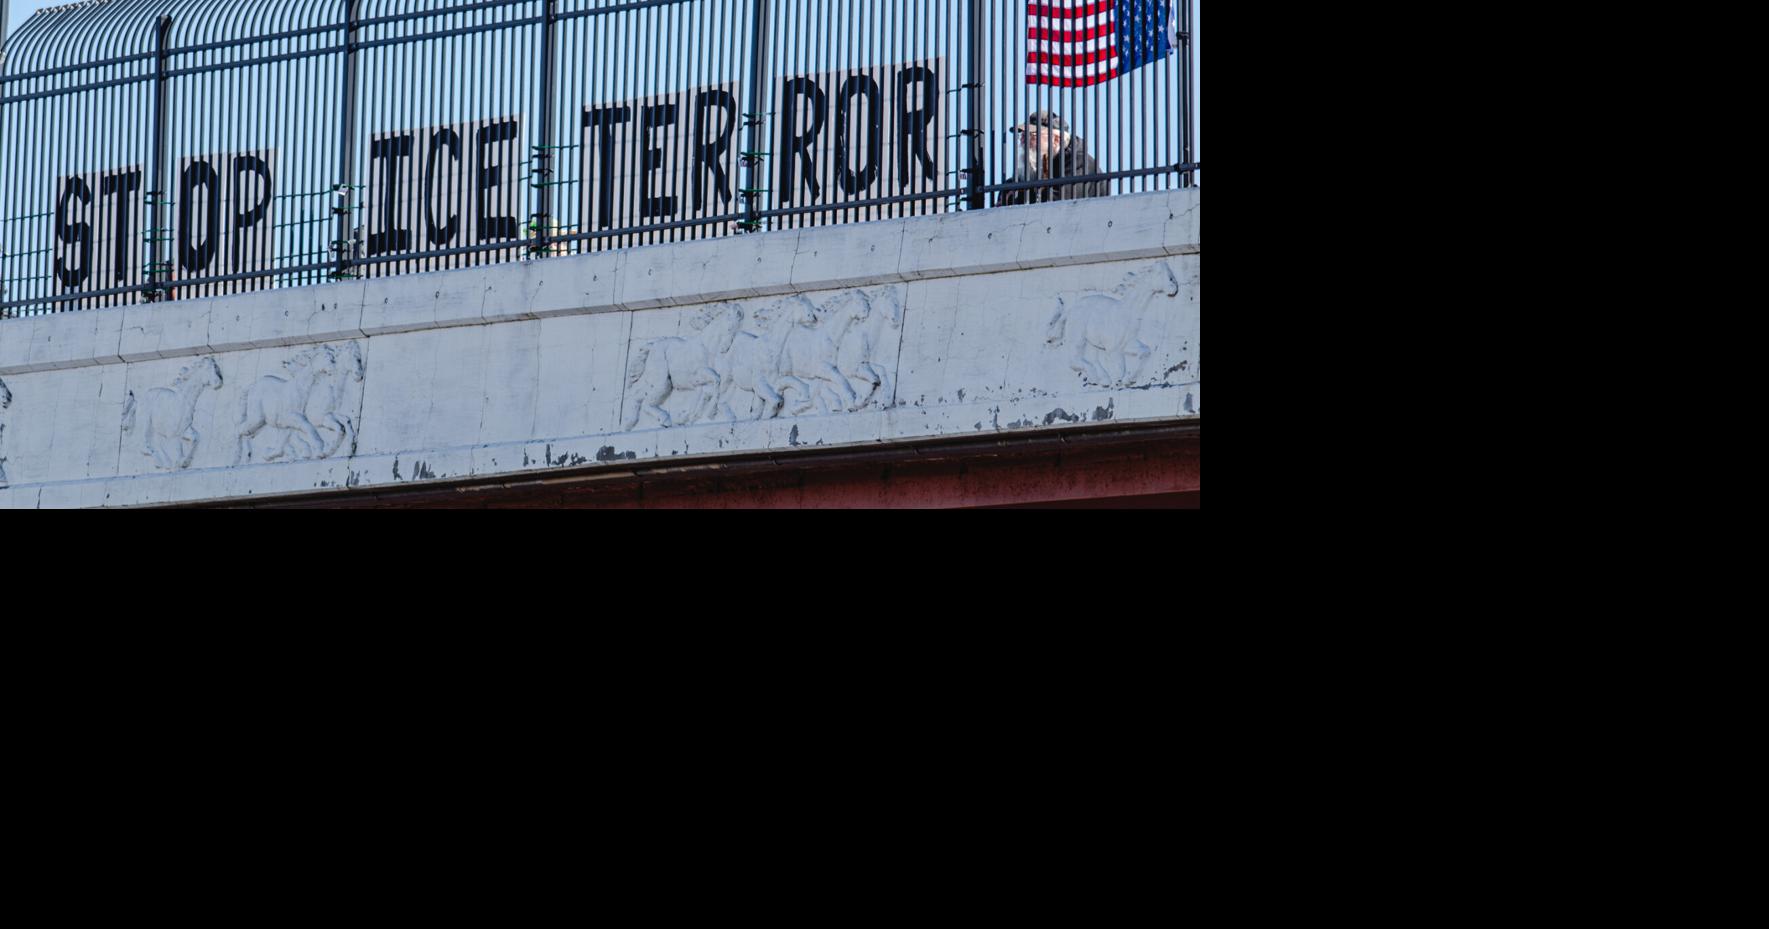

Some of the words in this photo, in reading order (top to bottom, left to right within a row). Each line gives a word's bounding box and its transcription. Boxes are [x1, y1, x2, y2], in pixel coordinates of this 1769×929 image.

[55, 155, 272, 287] STOP
[367, 120, 518, 256] ICE
[582, 66, 937, 228] TERROR
